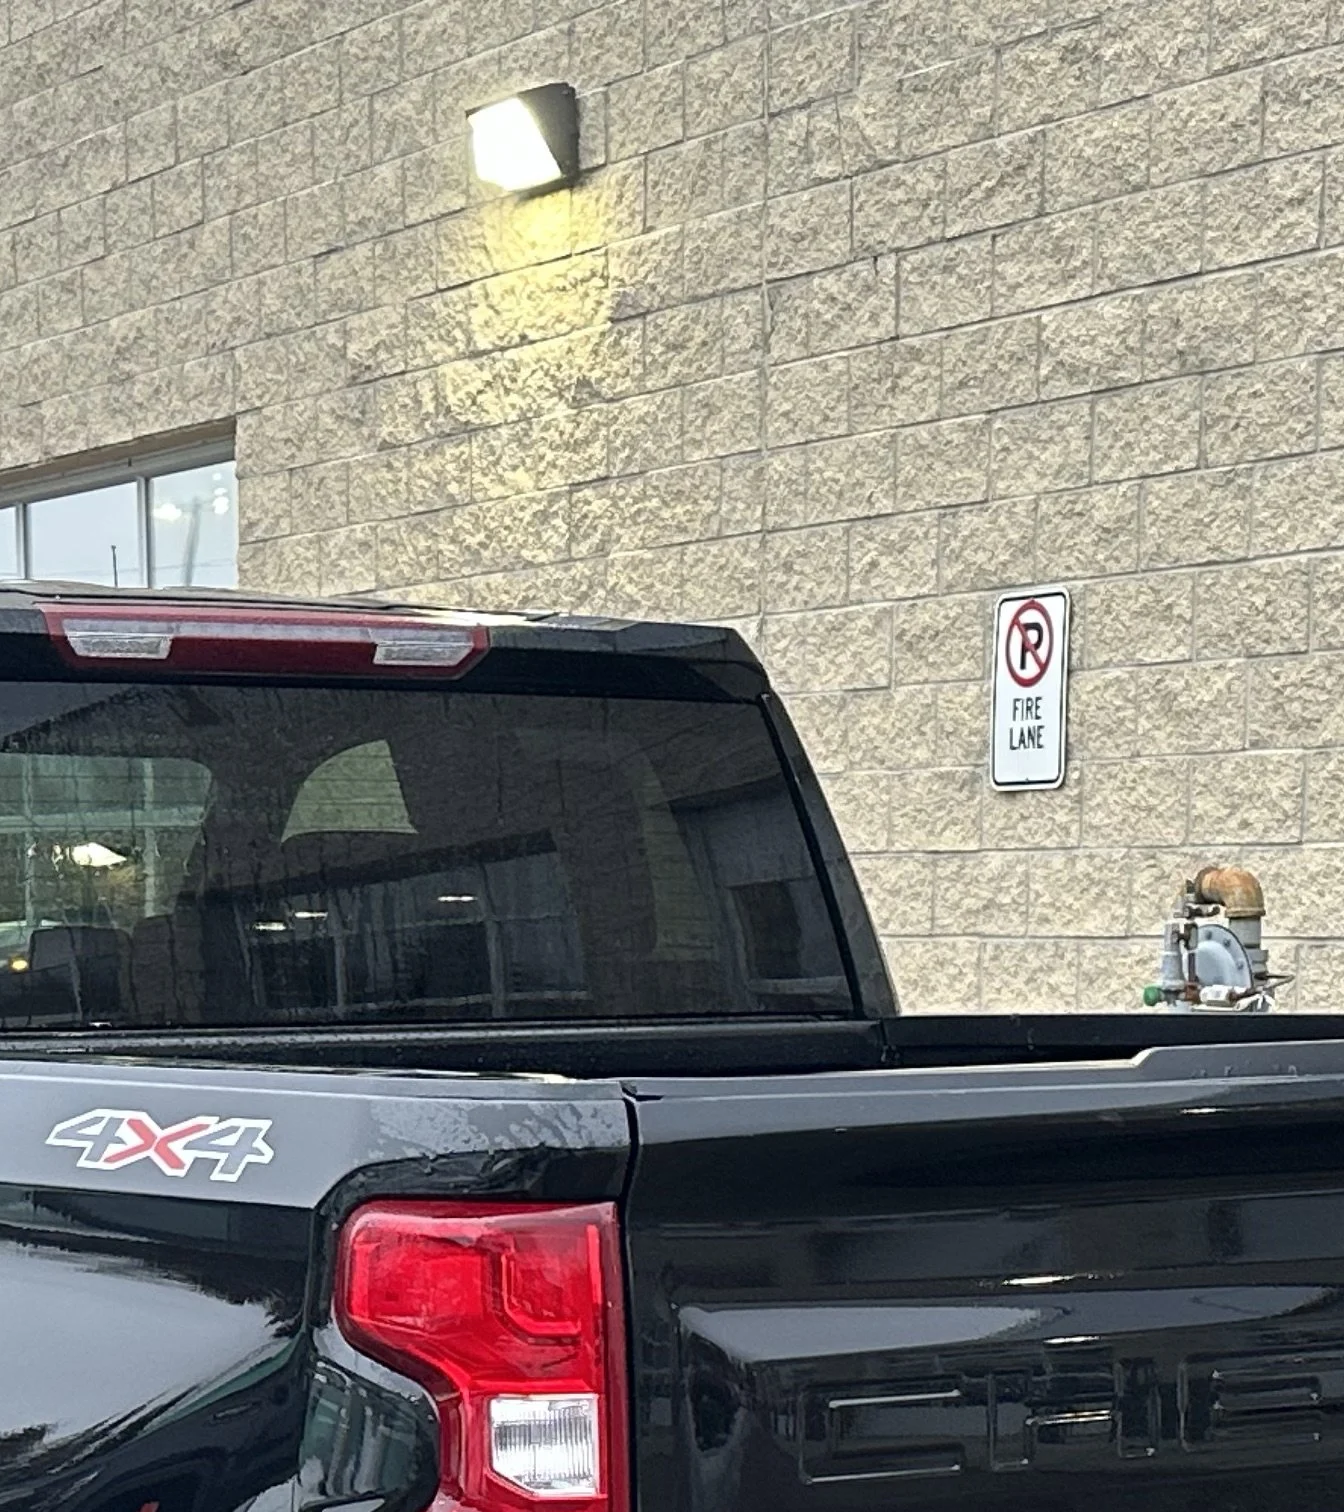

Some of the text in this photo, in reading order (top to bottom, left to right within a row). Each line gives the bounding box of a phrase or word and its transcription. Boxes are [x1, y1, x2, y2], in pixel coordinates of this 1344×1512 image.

[1020, 622, 1044, 670] P
[1012, 697, 1043, 722] FIRE
[1009, 725, 1045, 750] LANE
